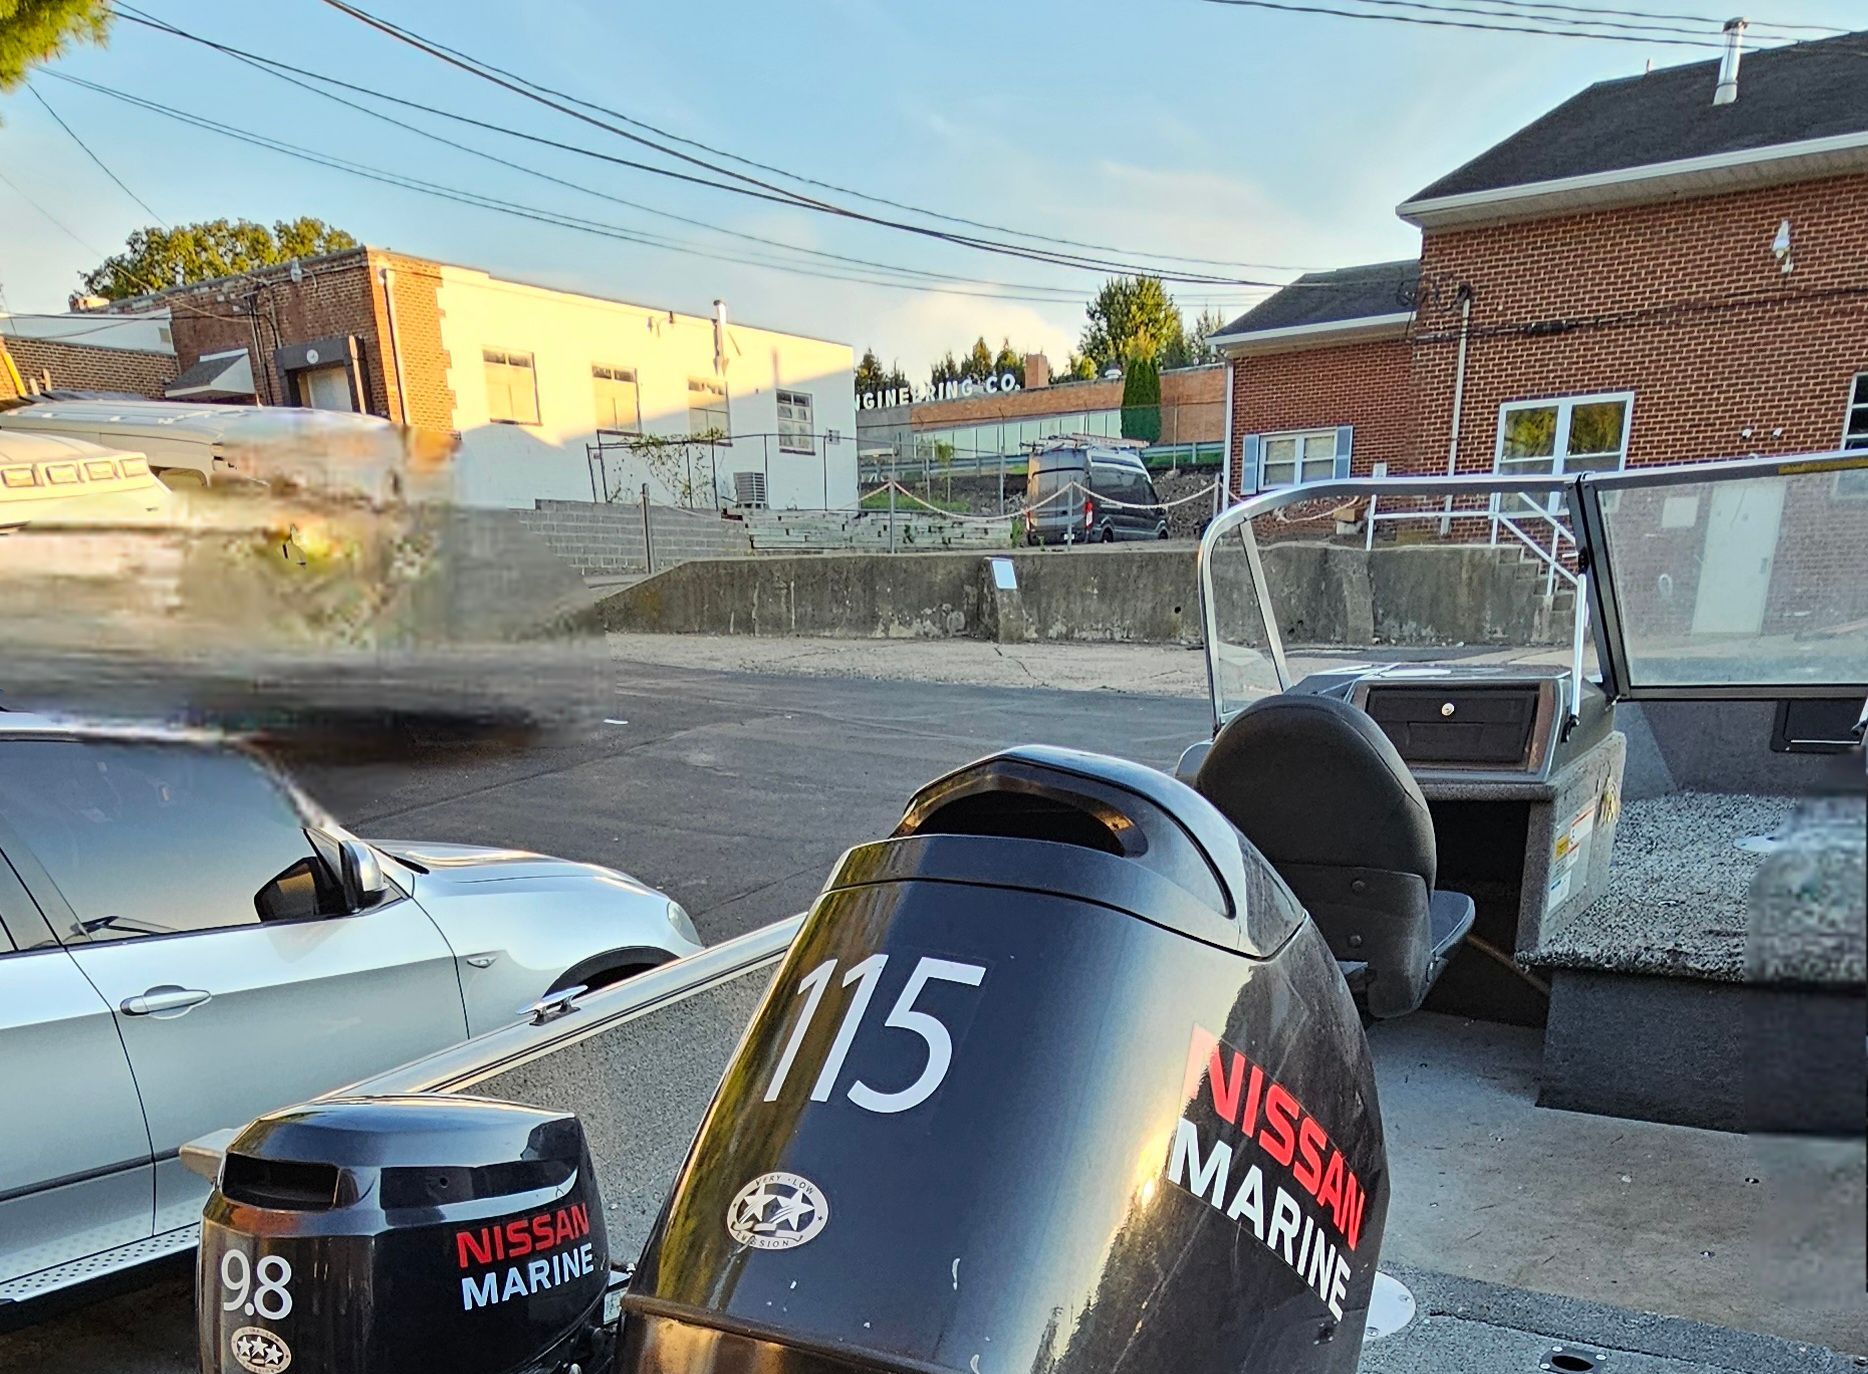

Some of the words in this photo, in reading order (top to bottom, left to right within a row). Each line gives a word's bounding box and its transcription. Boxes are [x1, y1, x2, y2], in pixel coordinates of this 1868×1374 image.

[986, 373, 1021, 394] CO.
[763, 953, 987, 1114] 115
[1189, 1022, 1367, 1252] NISSAN
[456, 1201, 590, 1268] NISSAN
[1168, 1118, 1353, 1321] MARINE
[220, 1248, 293, 1320] 9.8
[461, 1243, 594, 1311] MARINE
